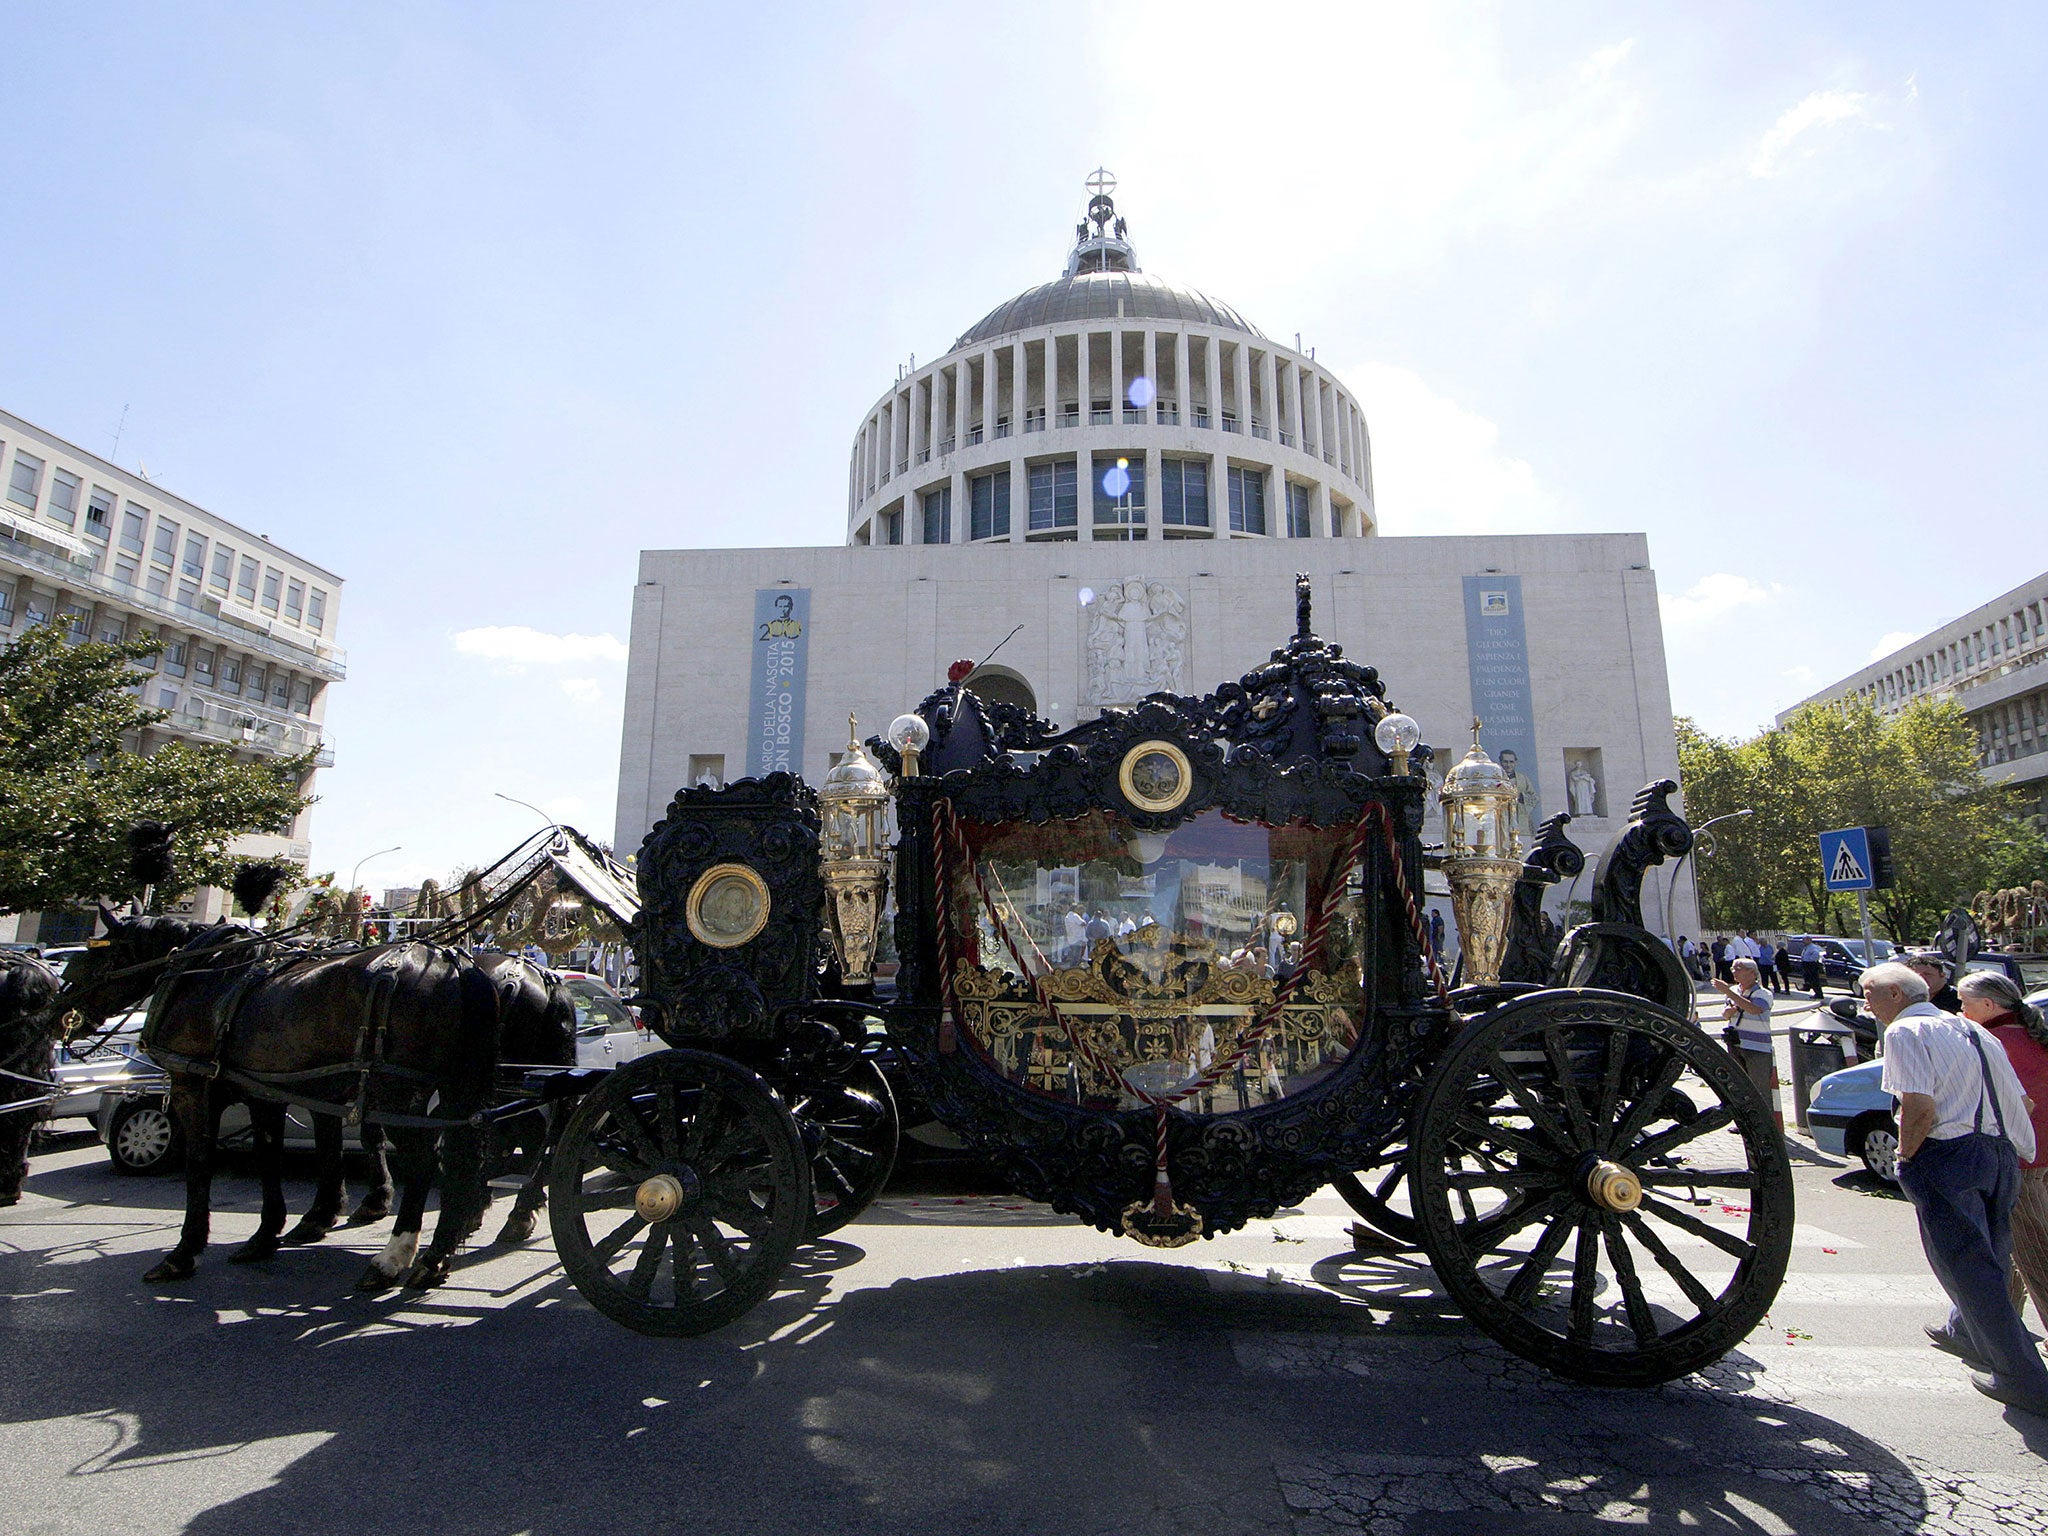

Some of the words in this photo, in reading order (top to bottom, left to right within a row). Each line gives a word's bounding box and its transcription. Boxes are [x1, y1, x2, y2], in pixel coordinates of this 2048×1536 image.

[765, 642, 779, 696] NASCITA
[780, 641, 795, 676] 2015
[1483, 690, 1520, 698] GRANDE
[1490, 703, 1517, 711] COME
[763, 699, 776, 736] DELLA
[777, 693, 792, 744] BOSCO
